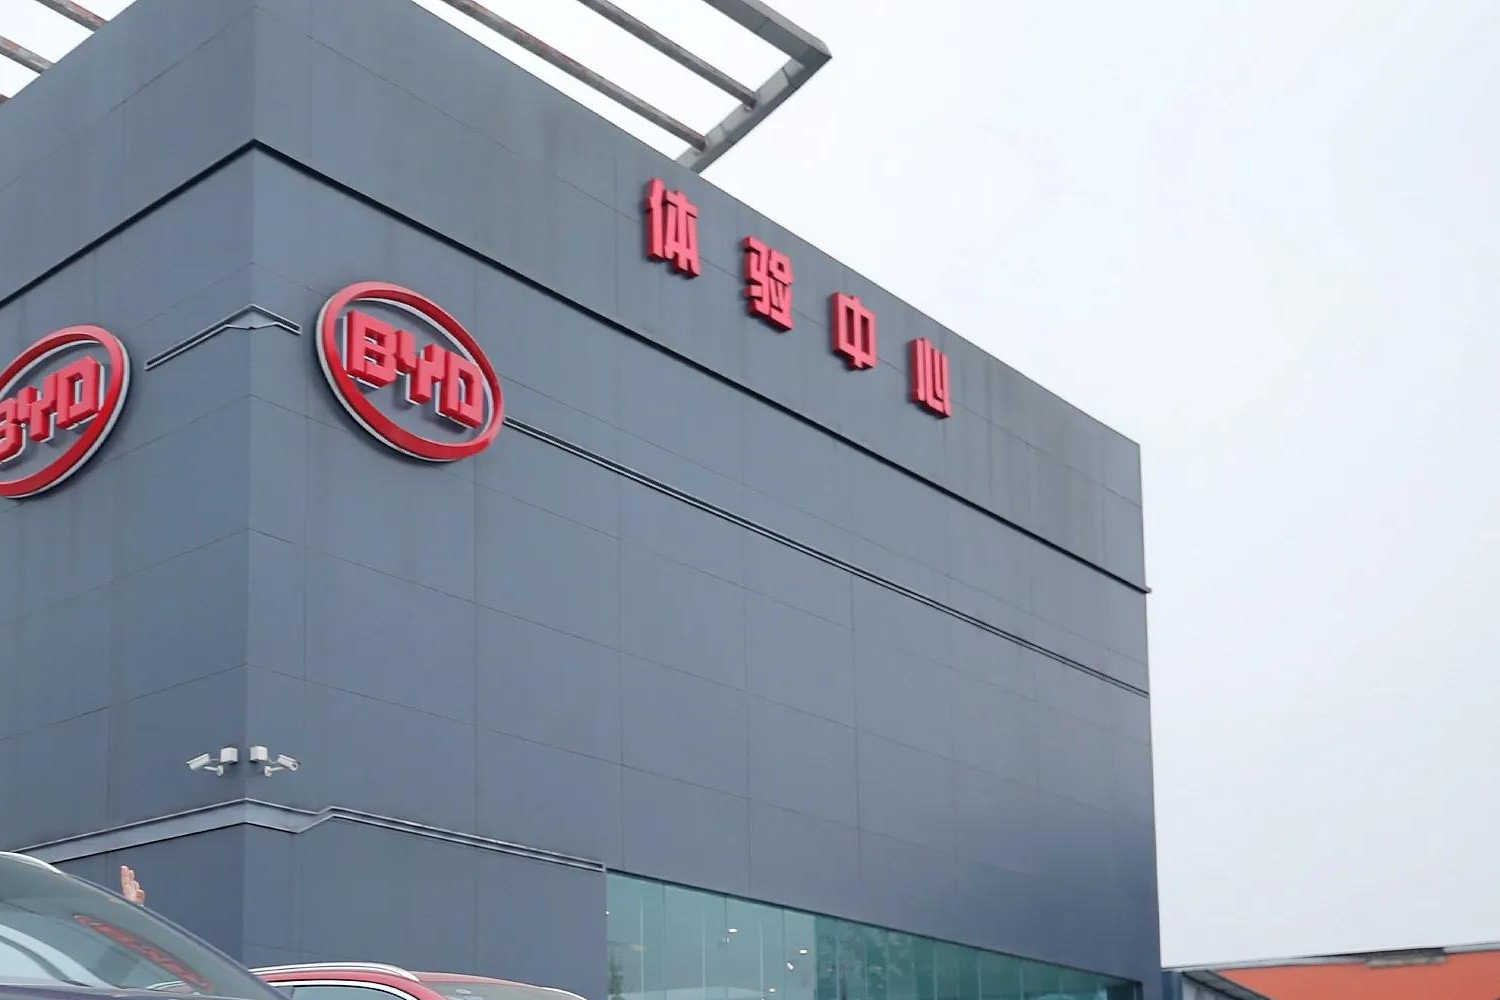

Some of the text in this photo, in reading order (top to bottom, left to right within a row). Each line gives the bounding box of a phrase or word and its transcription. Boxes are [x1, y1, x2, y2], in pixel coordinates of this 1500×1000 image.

[343, 310, 488, 430] BYD
[645, 178, 953, 418] 体验中心
